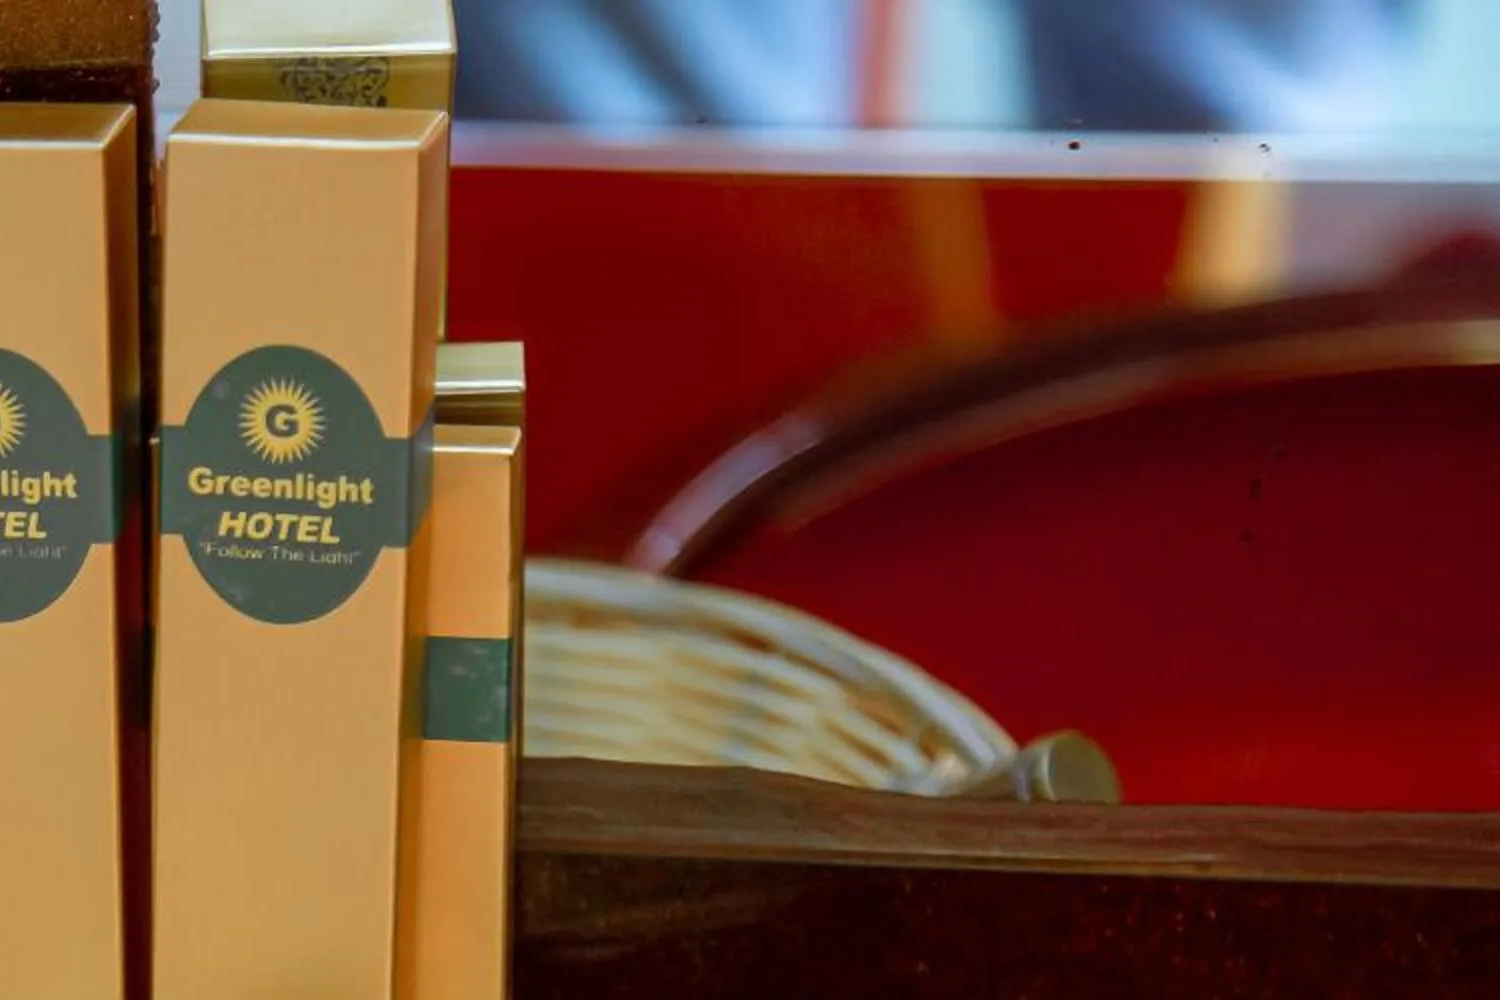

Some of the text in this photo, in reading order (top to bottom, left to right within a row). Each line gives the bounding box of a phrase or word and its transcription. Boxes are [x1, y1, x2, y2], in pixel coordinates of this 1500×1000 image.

[265, 403, 299, 438] G
[188, 467, 374, 509] Greenlight
[218, 511, 341, 545] HOTEL
